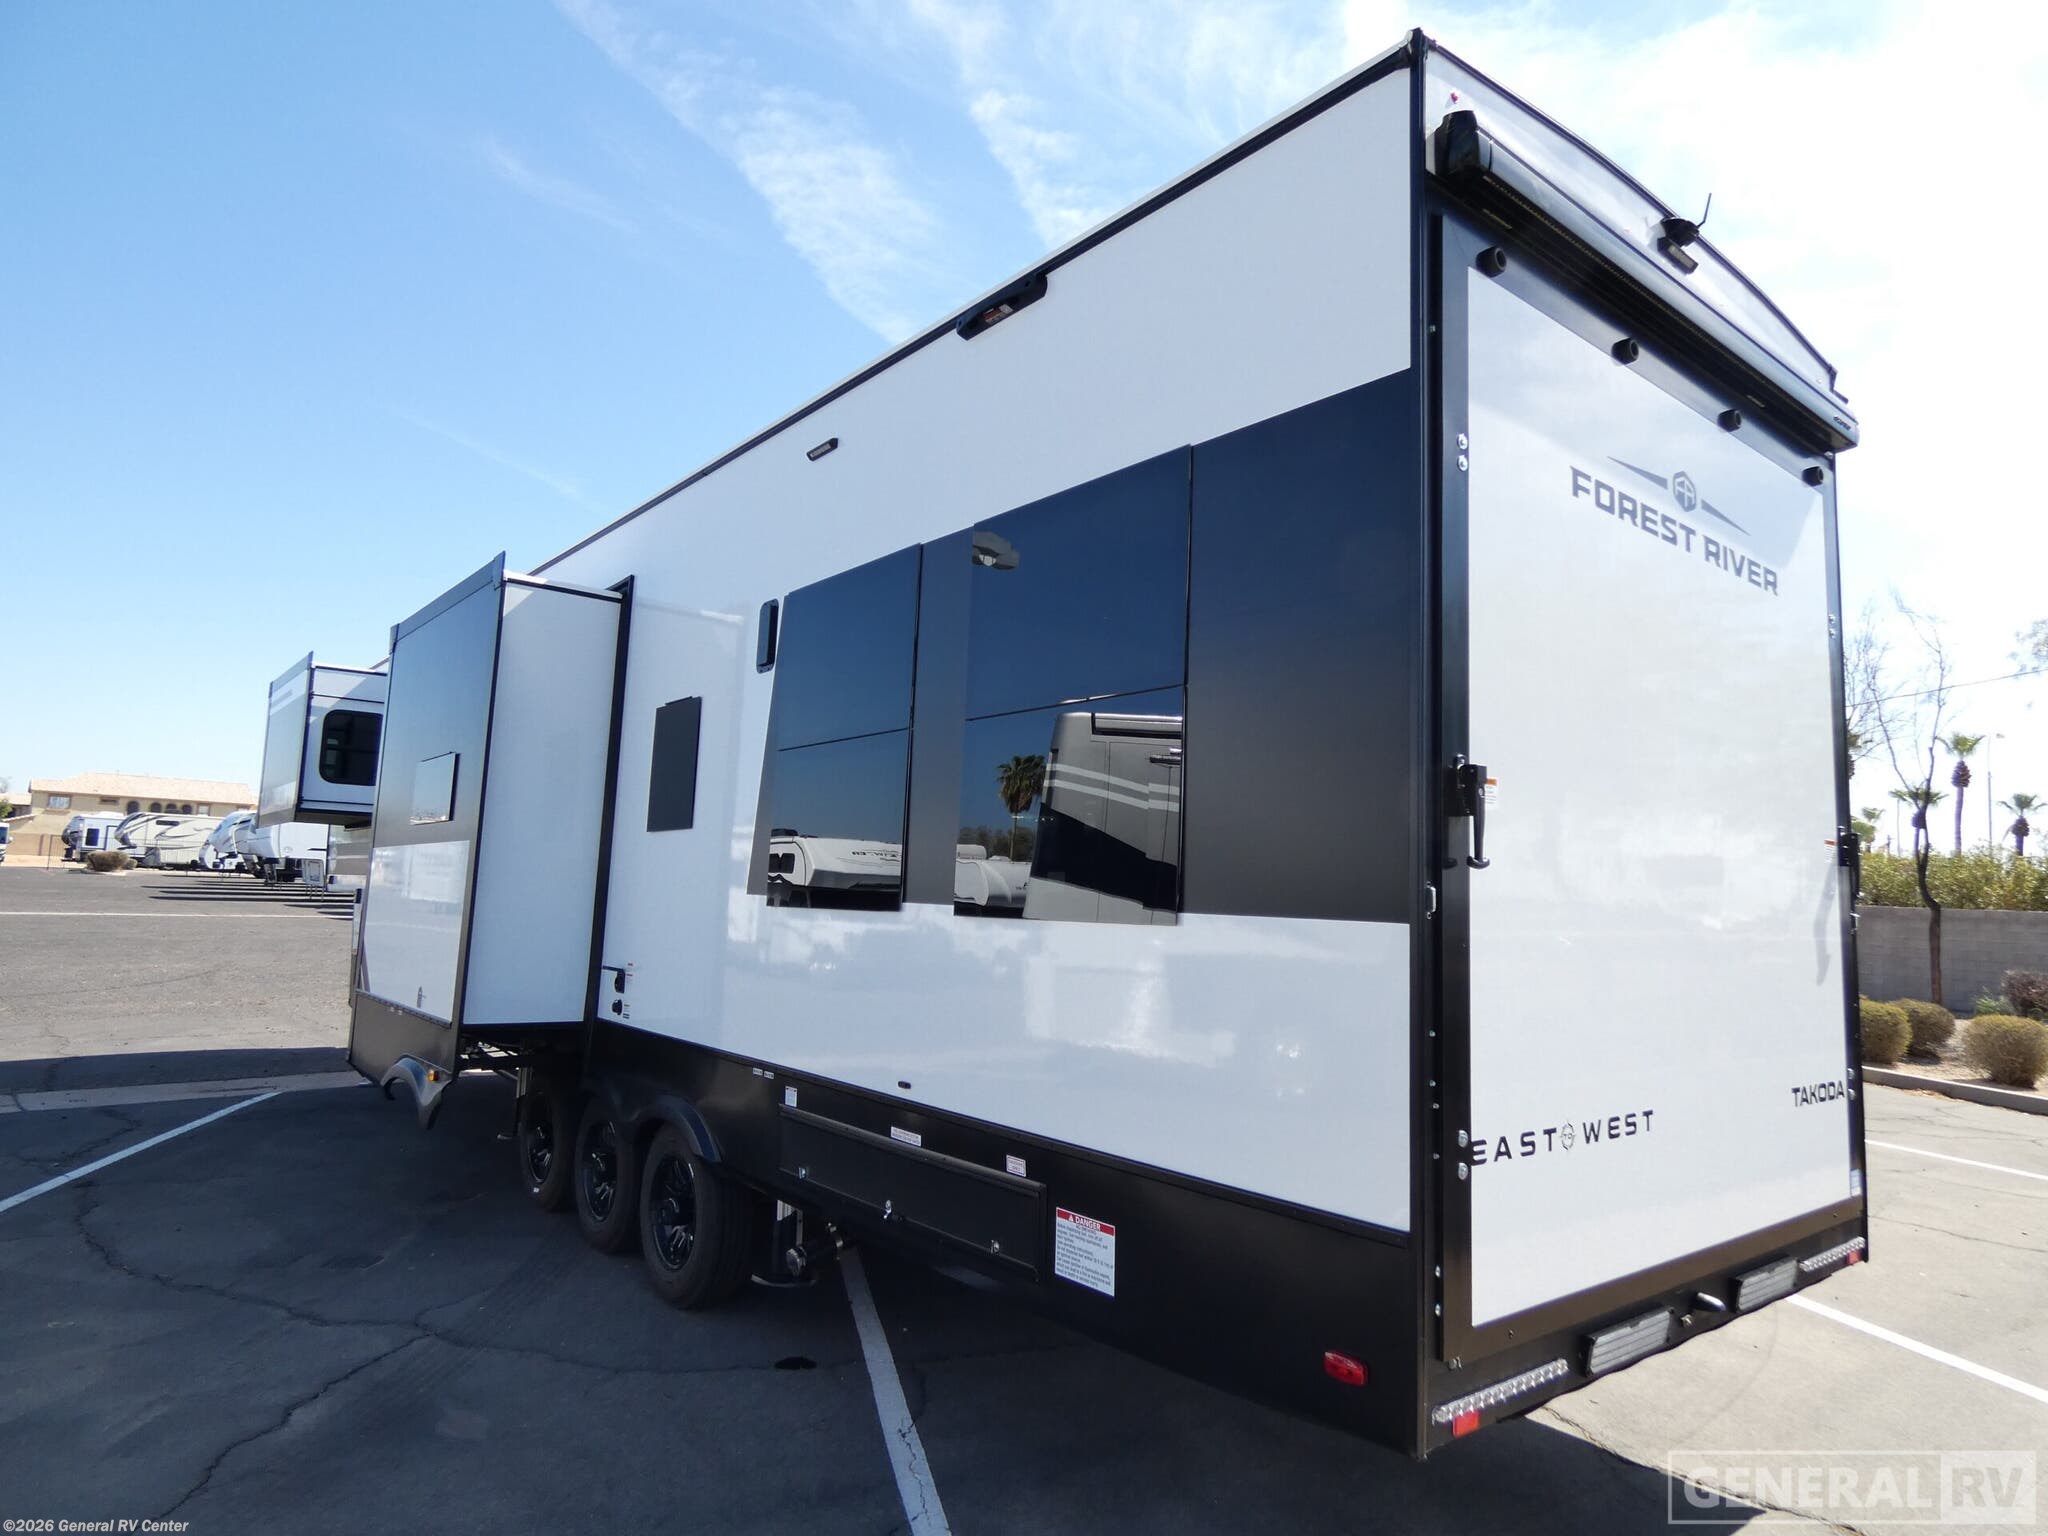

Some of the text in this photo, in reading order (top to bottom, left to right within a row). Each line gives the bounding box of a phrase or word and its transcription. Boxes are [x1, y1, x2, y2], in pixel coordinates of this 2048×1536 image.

[1569, 465, 1778, 596] FOREST RIVER
[1791, 1080, 1845, 1107] TAKODA
[1471, 1127, 1557, 1166] EAST
[1582, 1109, 1654, 1145] WEST
[1075, 1216, 1101, 1231] DANGER
